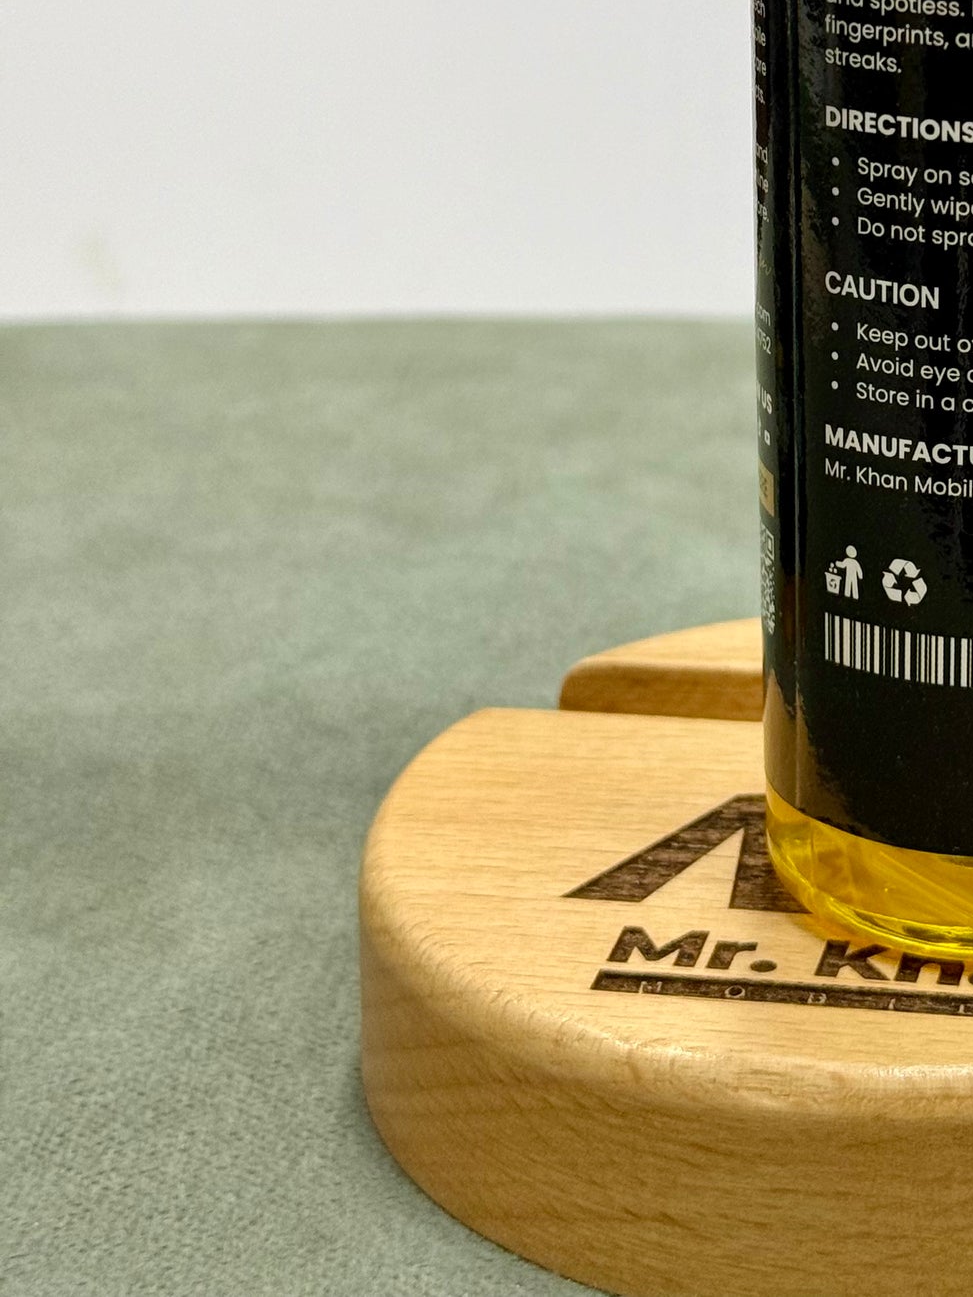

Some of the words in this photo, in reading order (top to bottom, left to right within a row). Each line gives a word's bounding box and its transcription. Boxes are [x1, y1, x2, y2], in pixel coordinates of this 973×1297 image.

[824, 13, 950, 51] fingerprints,
[824, 47, 902, 74] streaks.
[857, 156, 919, 187] Spray
[923, 168, 953, 186] on
[856, 186, 926, 219] Gently
[857, 216, 886, 238] Do
[890, 224, 926, 243] not
[824, 270, 940, 310] CAUTION
[856, 322, 909, 352] Keep
[914, 333, 952, 352] out
[855, 352, 914, 378] Avoid
[919, 364, 961, 387] eye
[856, 381, 910, 407] Store
[915, 388, 935, 410] in
[940, 396, 956, 412] a
[824, 457, 851, 481] Mr.
[856, 465, 908, 492] Khan
[607, 924, 778, 973] Mr.
